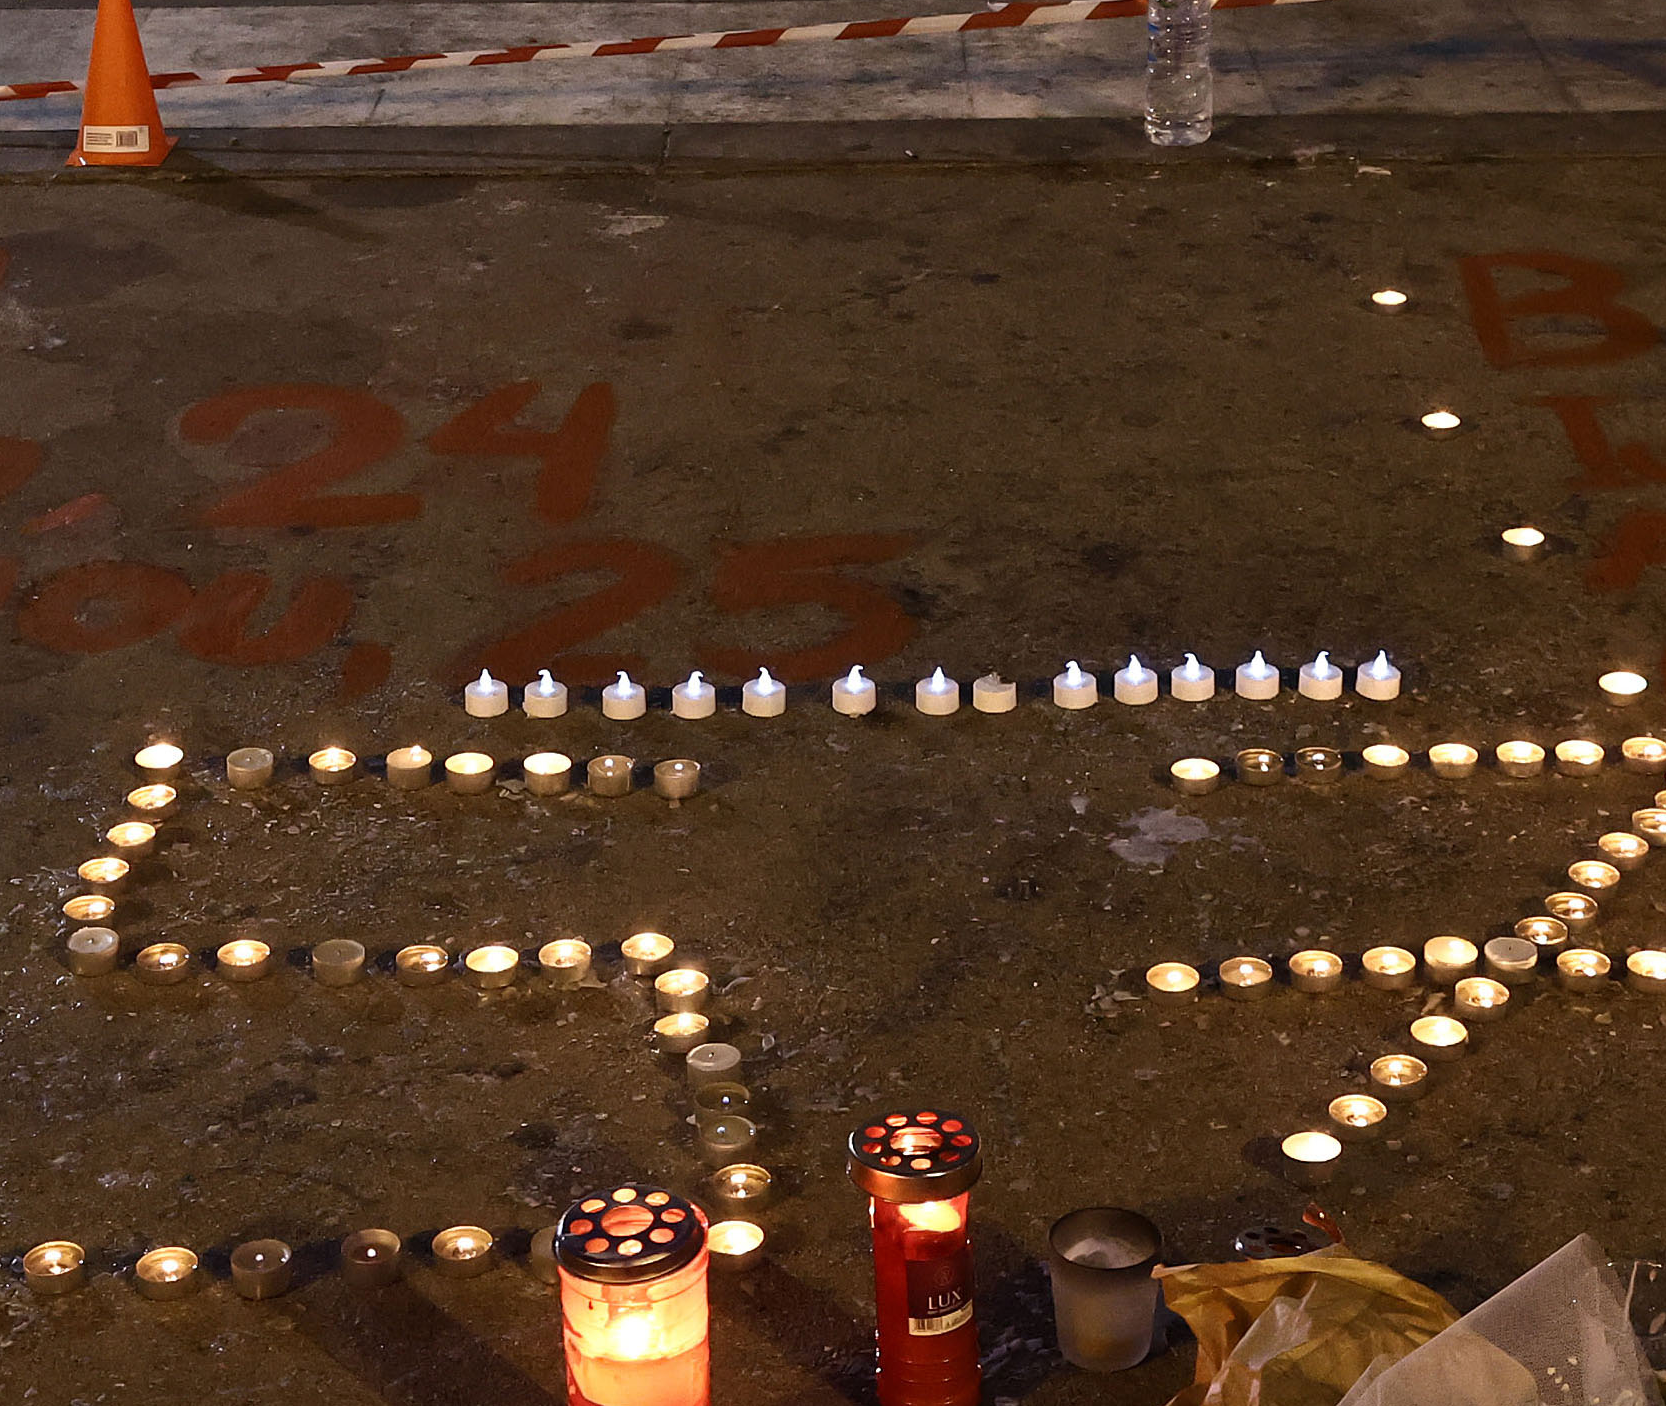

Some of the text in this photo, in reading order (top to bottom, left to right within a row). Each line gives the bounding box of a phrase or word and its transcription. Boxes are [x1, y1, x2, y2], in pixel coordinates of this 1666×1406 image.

[179, 380, 620, 535] 24
[444, 532, 923, 692] 25
[928, 1284, 963, 1310] LUX
